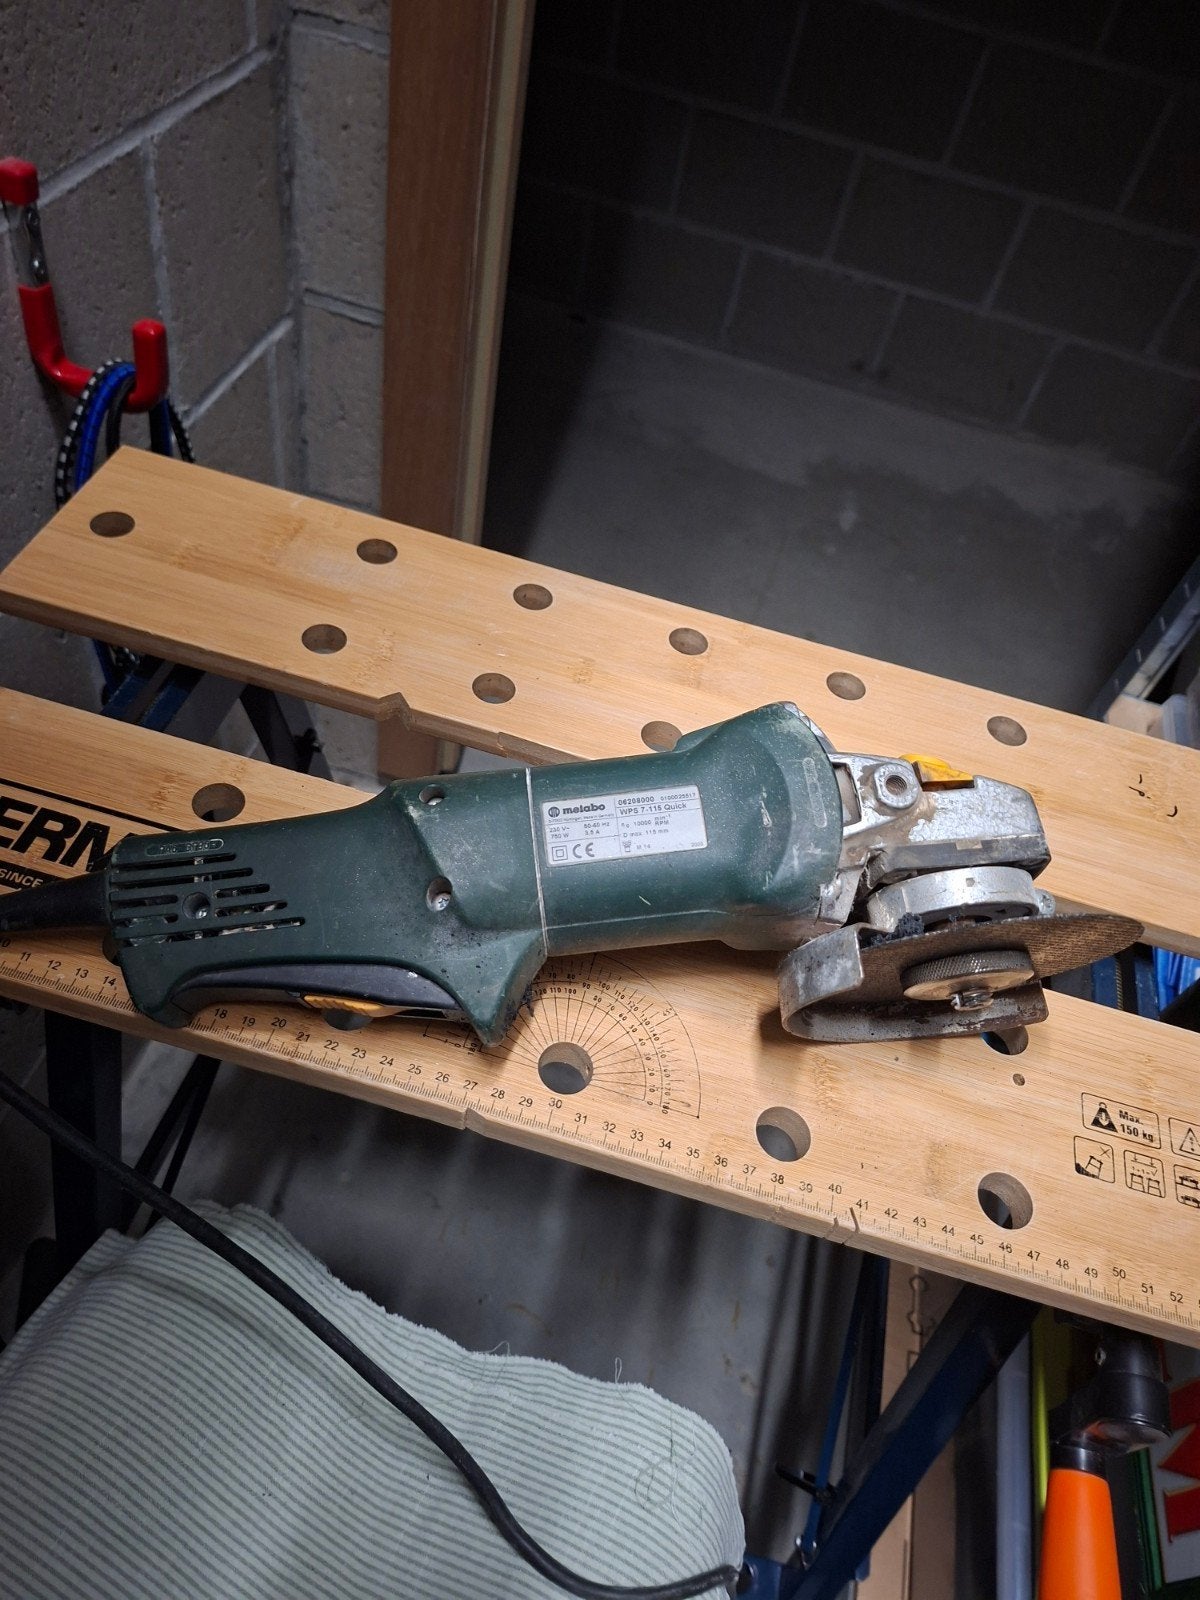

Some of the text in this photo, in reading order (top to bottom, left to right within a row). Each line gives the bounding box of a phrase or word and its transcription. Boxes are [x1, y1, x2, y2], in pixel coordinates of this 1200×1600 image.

[562, 803, 605, 814] metabo
[619, 801, 687, 816] WPS 7-115 Quick
[0, 868, 44, 888] SINCE
[614, 990, 625, 1000] 110
[627, 1000, 639, 1012] 120
[640, 1014, 650, 1026] 130
[650, 1027, 660, 1042] 140
[606, 1003, 615, 1011] 70
[618, 1013, 627, 1021] 60
[629, 1024, 638, 1033] 50
[638, 1038, 645, 1046] 40
[648, 1068, 655, 1076] 20
[20, 952, 32, 962] 11
[48, 960, 61, 971] 12
[75, 968, 89, 979] 13
[103, 976, 116, 986] 14
[214, 1008, 227, 1019] 18
[242, 1016, 256, 1027] 19
[271, 1017, 286, 1028] 20
[296, 1032, 311, 1042] 21
[324, 1040, 339, 1051] 22
[352, 1048, 366, 1059] 23
[379, 1056, 394, 1067] 24
[407, 1063, 422, 1074] 25
[435, 1072, 450, 1082] 26
[464, 1080, 477, 1090] 27
[490, 1088, 505, 1099] 28
[519, 1096, 533, 1107] 29
[548, 1098, 562, 1109] 30
[574, 1113, 588, 1124] 31
[602, 1121, 616, 1133] 32
[630, 1130, 644, 1141] 33
[658, 1138, 672, 1150] 34
[686, 1147, 700, 1158] 35
[714, 1155, 728, 1167] 36
[743, 1164, 756, 1175] 37
[771, 1173, 784, 1184] 38
[799, 1181, 812, 1193] 39
[828, 1183, 842, 1194] 40
[856, 1199, 869, 1210] 41
[884, 1208, 898, 1219] 42
[913, 1216, 927, 1228] 43
[941, 1225, 955, 1236] 44
[970, 1234, 984, 1245] 45
[999, 1242, 1012, 1253] 46
[1027, 1250, 1040, 1261] 47
[1056, 1259, 1069, 1270] 48
[1084, 1267, 1098, 1278] 49
[1112, 1267, 1126, 1279] 50
[1141, 1283, 1153, 1295] 51
[1170, 1291, 1183, 1303] 52
[1120, 1123, 1154, 1143] 150 kg
